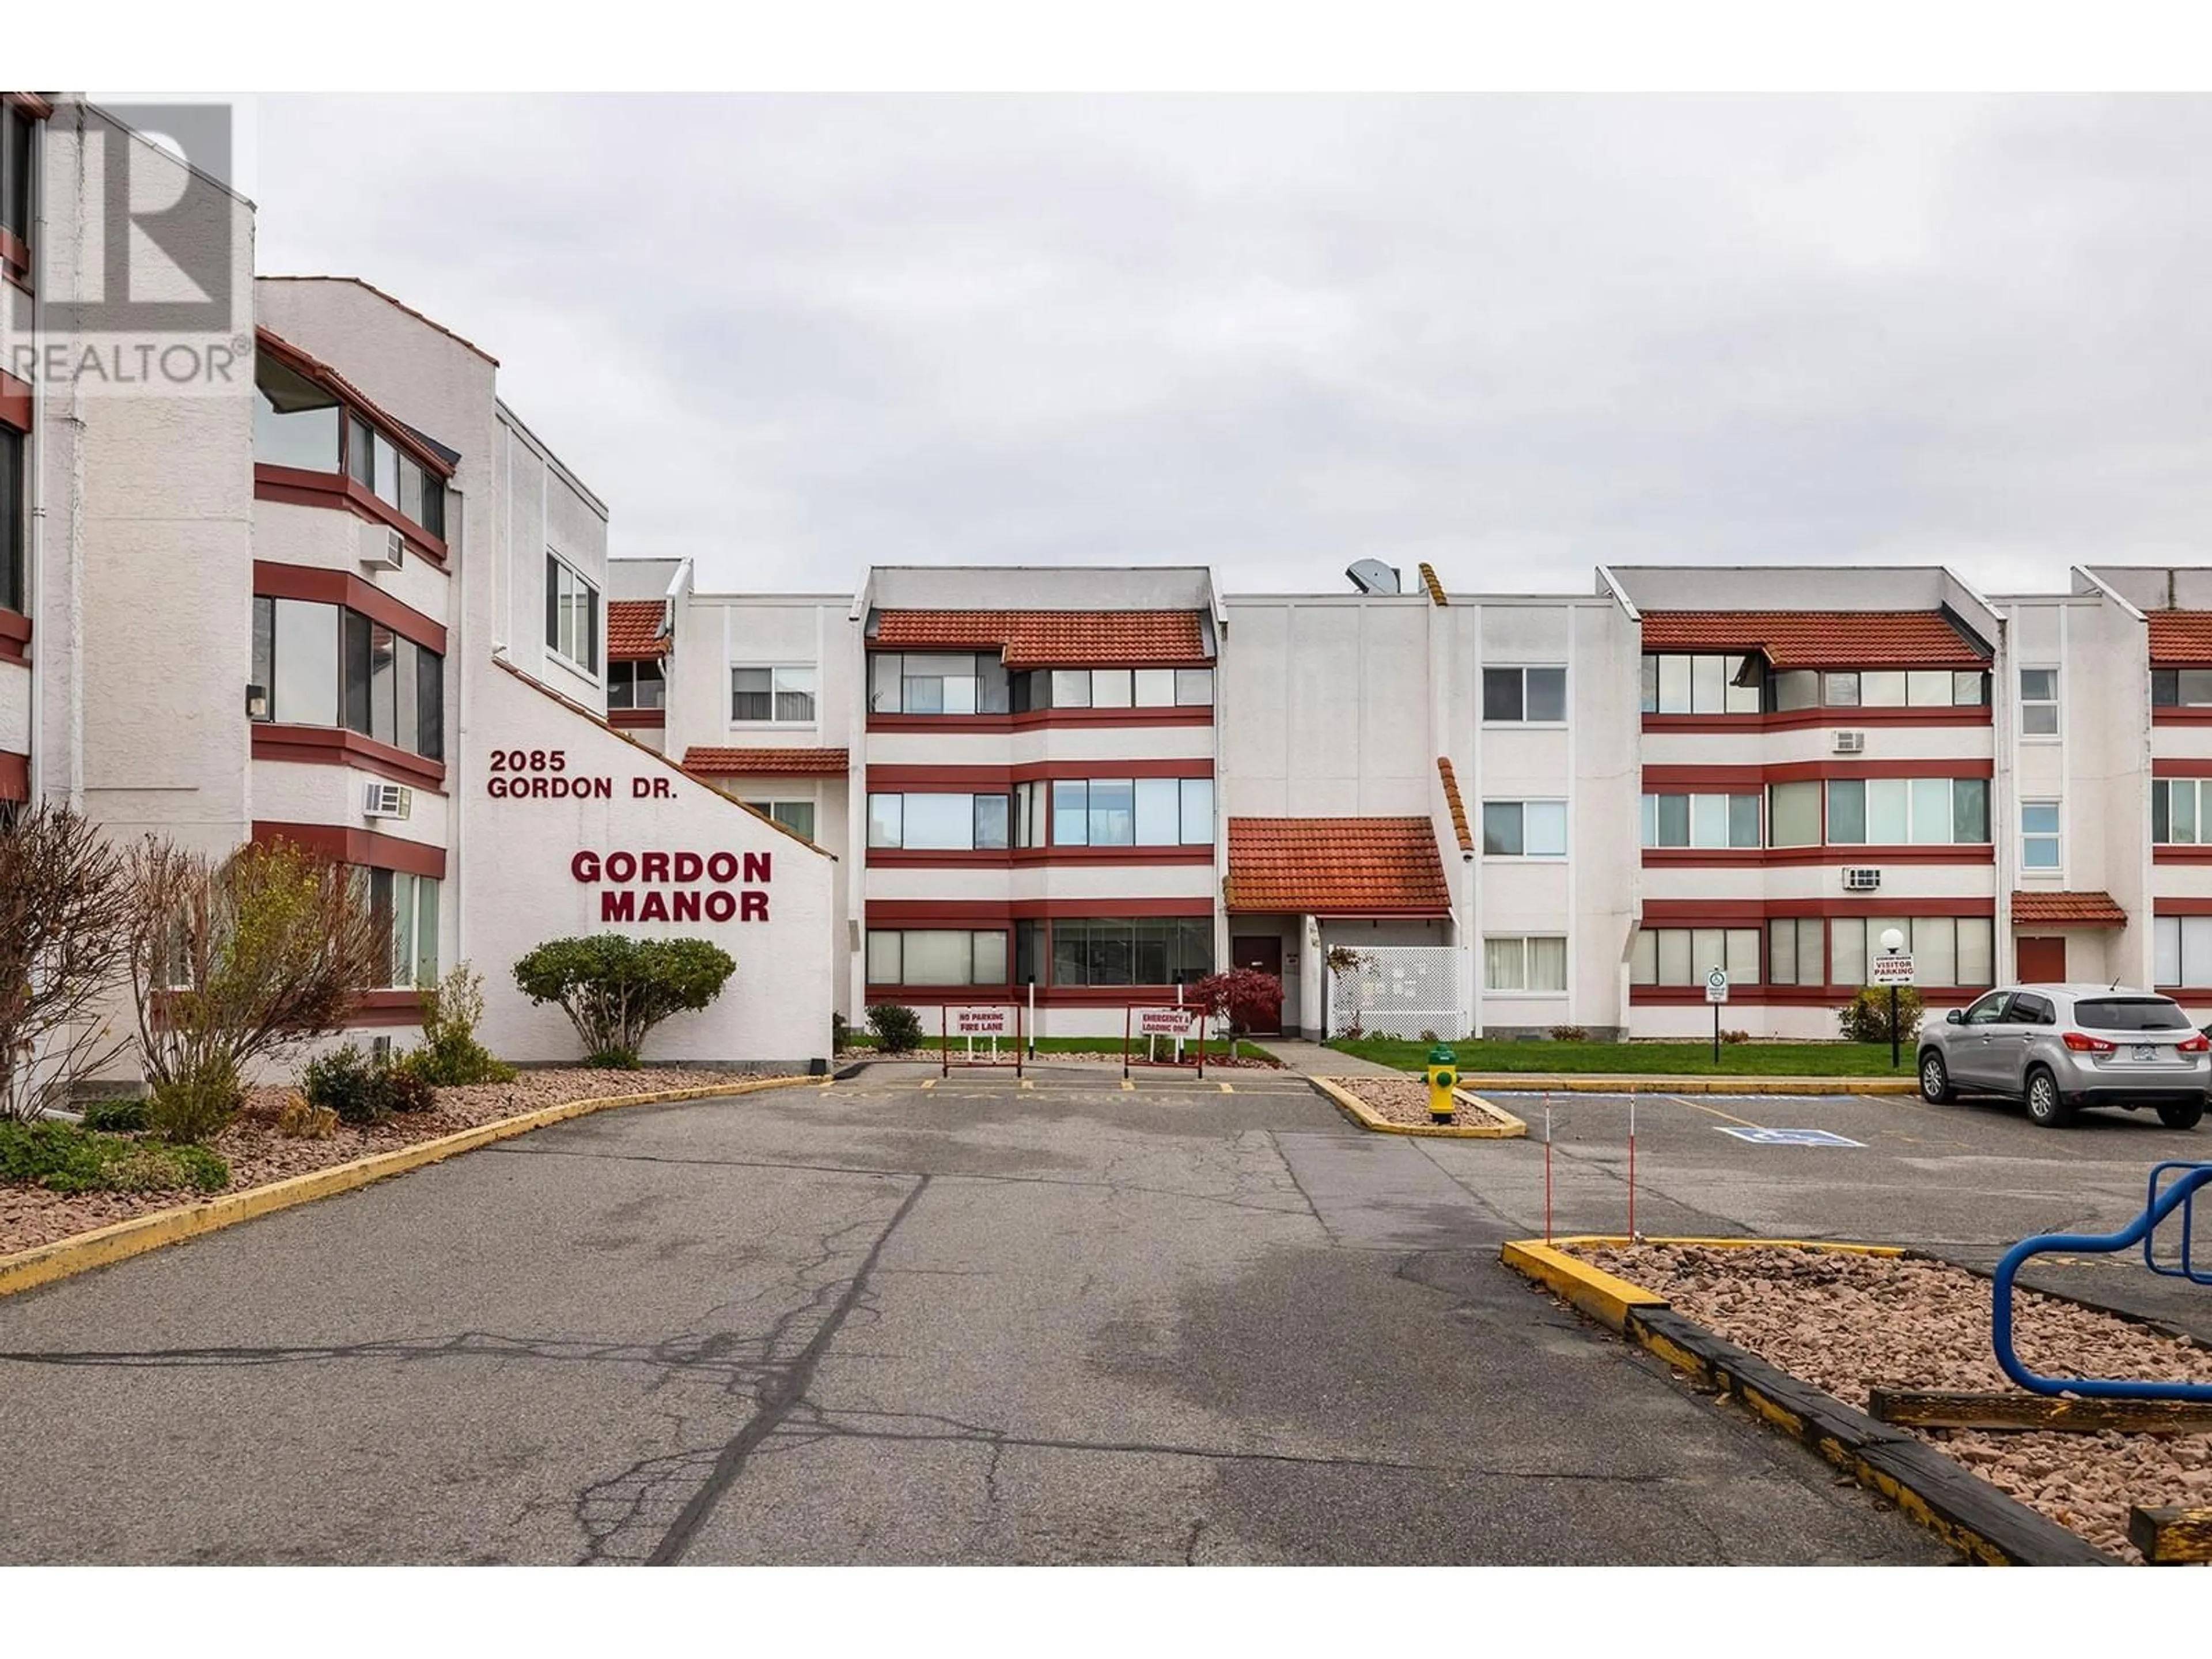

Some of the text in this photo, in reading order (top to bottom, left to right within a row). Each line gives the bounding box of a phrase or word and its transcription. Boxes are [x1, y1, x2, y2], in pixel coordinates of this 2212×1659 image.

[490, 750, 566, 772] 2085
[487, 777, 677, 798] GORDON DR.
[571, 850, 771, 883] GORDON
[601, 891, 770, 922] MANOR
[972, 1013, 1003, 1021] PARKING
[1142, 1014, 1184, 1023] EMERGENCY
[960, 1022, 1003, 1031] FIRE LANE
[1142, 1023, 1171, 1032] LOADING
